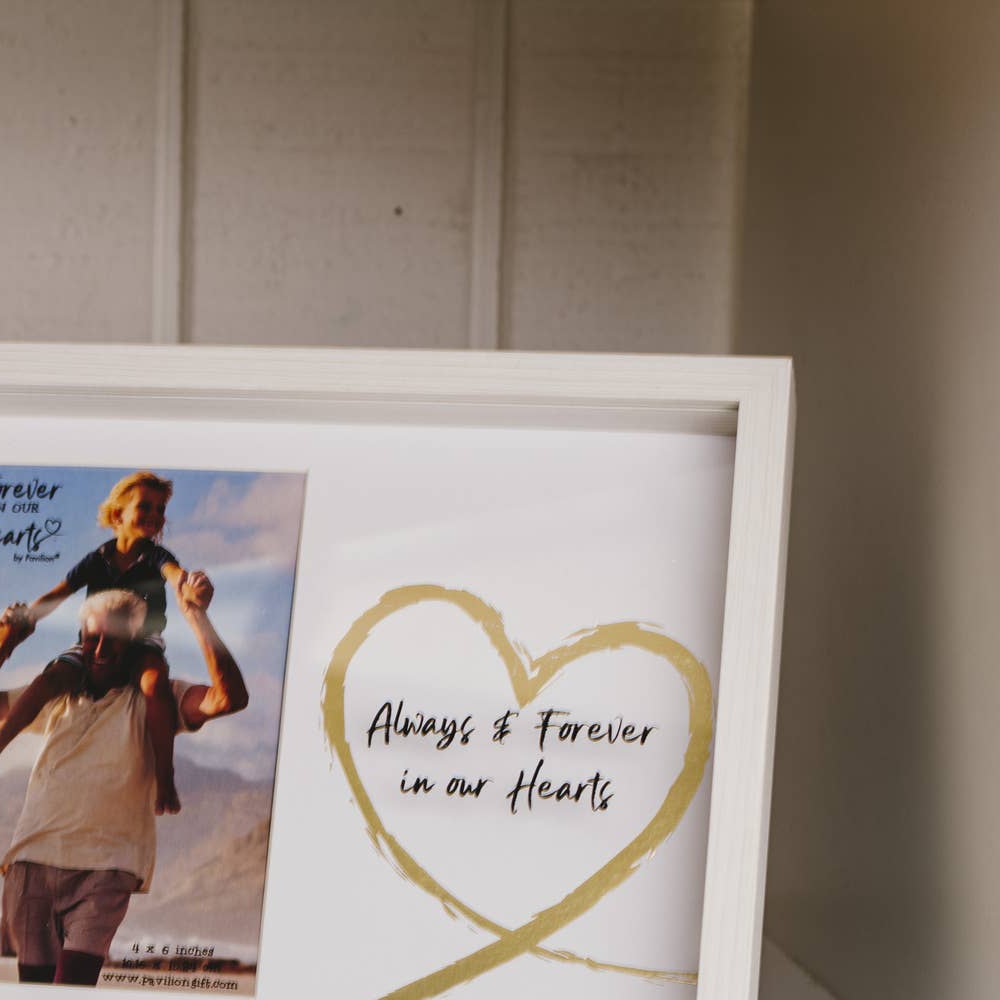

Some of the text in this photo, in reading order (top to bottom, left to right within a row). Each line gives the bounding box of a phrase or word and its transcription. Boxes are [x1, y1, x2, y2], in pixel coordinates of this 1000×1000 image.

[12, 503, 40, 513] OUR
[13, 553, 24, 563] by
[366, 700, 474, 750] Always
[534, 708, 658, 752] Forever
[400, 758, 615, 814] in our Hearts
[132, 943, 215, 957] 4 x 6 inches
[102, 973, 238, 991] www.paviliongift.com
